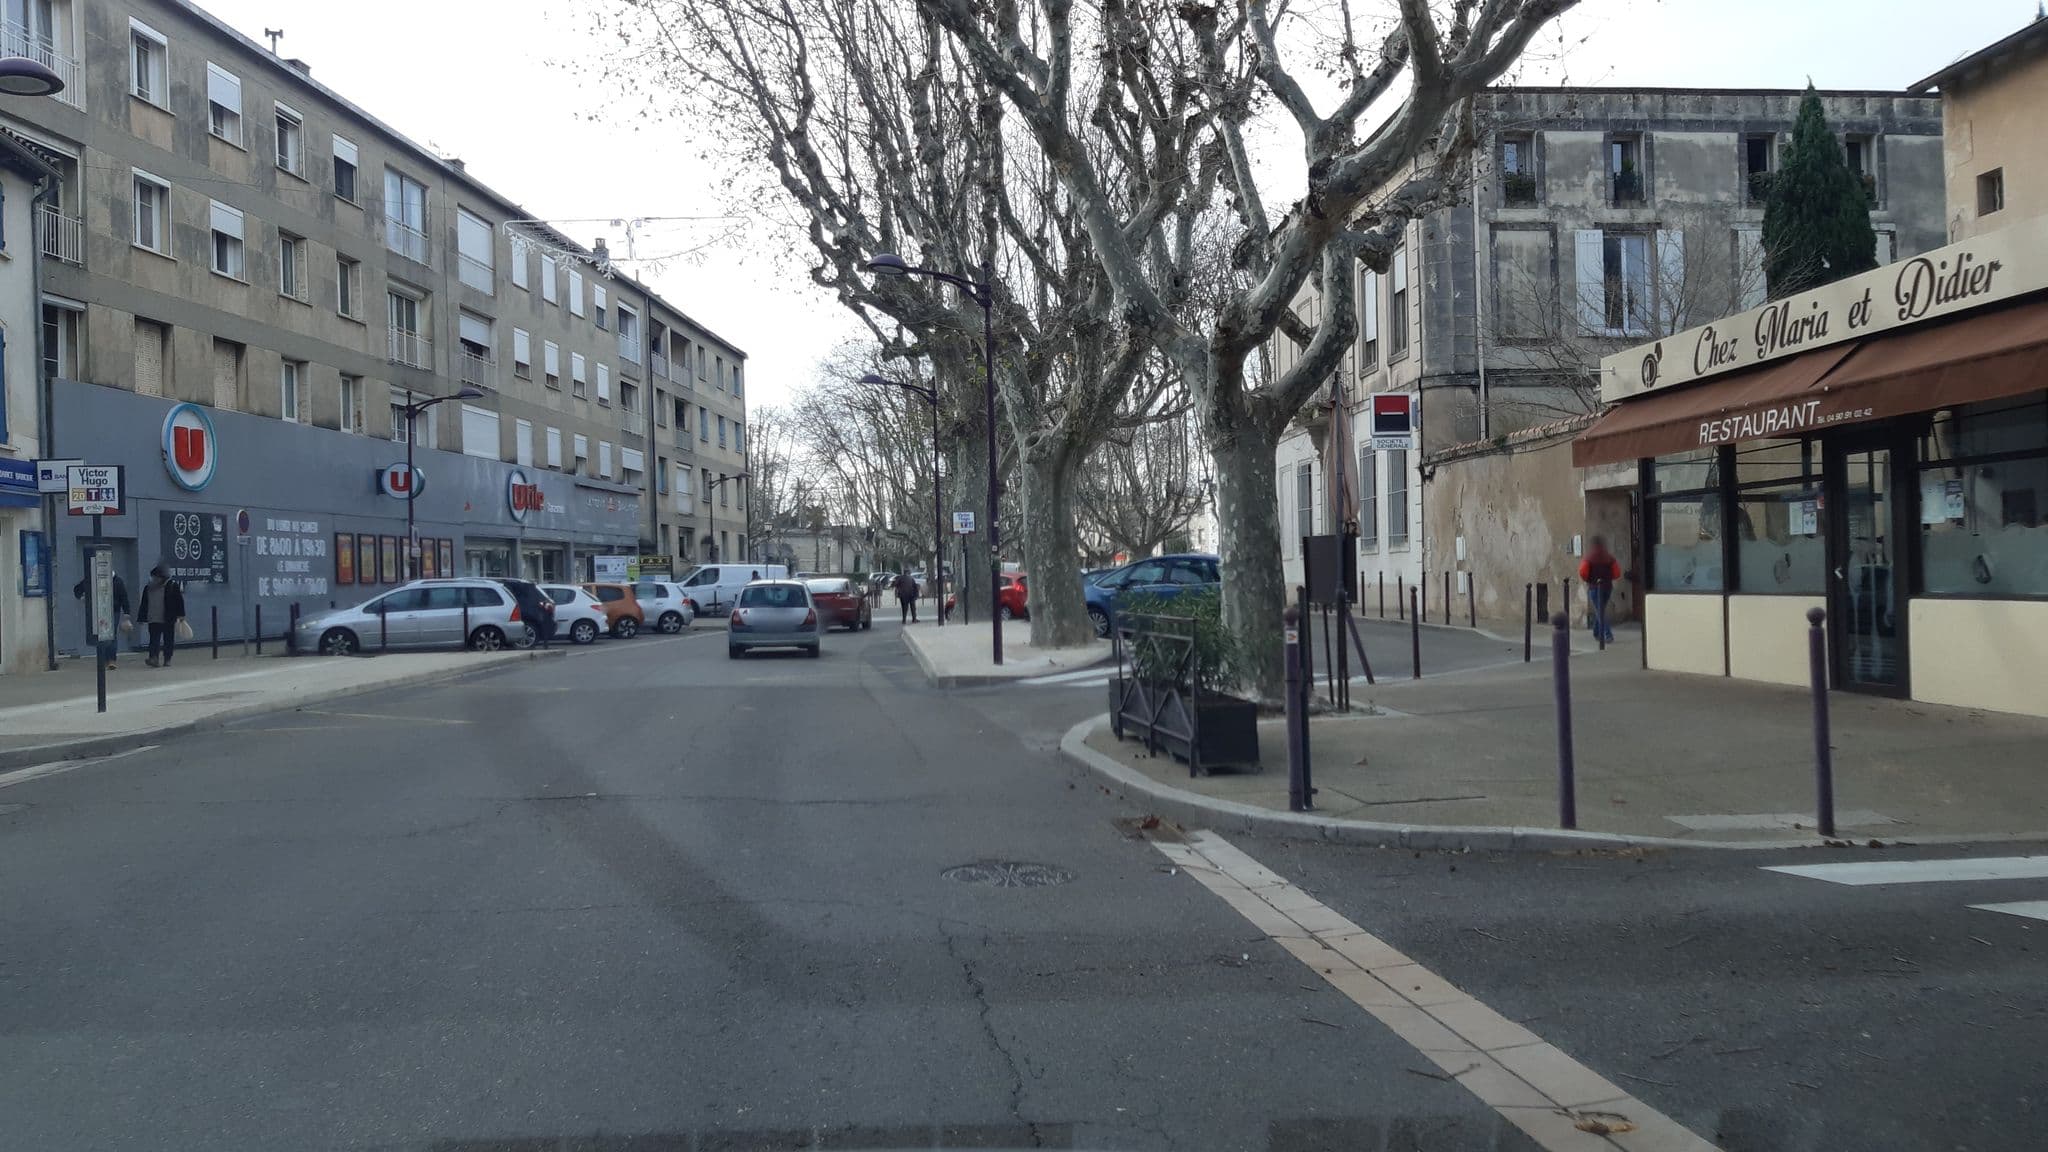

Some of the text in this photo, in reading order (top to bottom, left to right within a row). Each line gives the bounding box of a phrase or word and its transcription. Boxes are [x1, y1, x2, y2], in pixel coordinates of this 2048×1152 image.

[1694, 253, 2003, 376] Chez Maria et Didier
[1699, 400, 1821, 444] RESTAURANT
[174, 426, 205, 471] U
[78, 468, 108, 478] Victor
[81, 477, 108, 487] Hugo
[391, 472, 410, 491] U
[72, 492, 85, 501] 20
